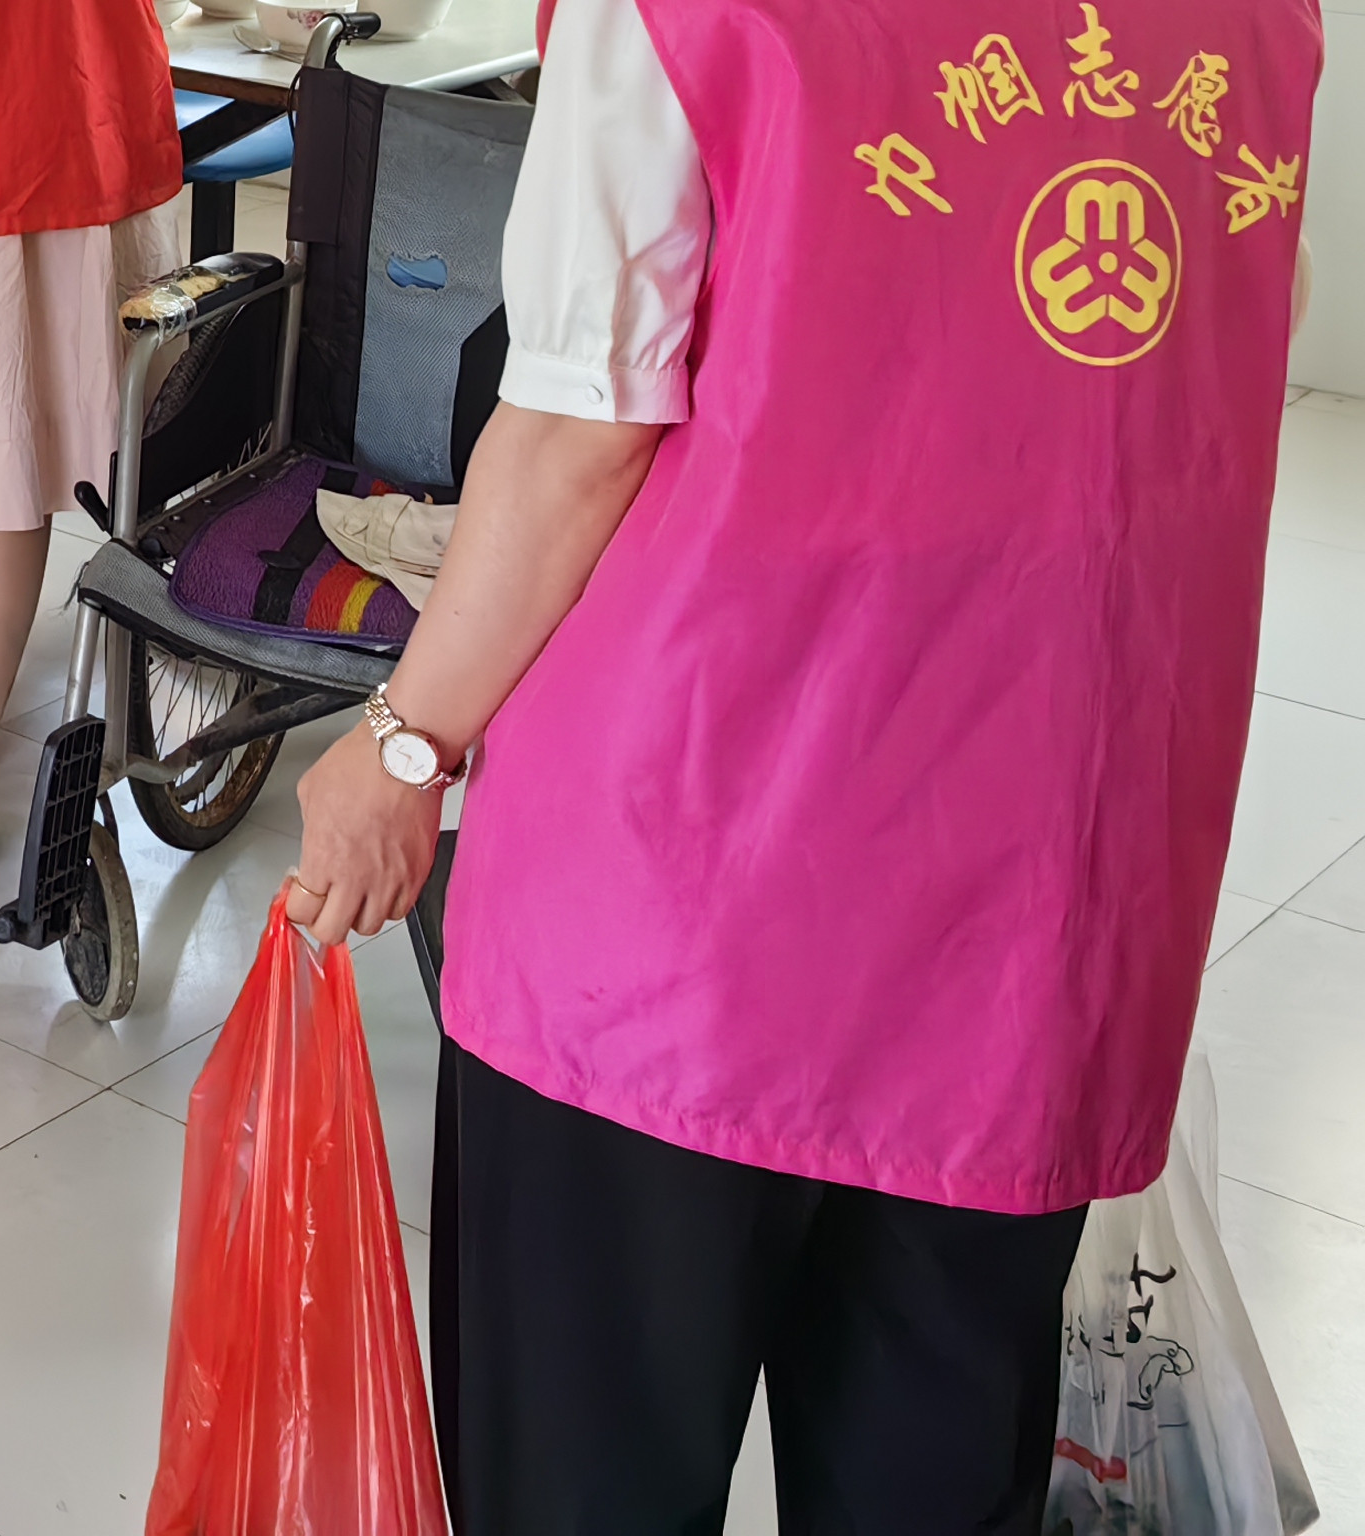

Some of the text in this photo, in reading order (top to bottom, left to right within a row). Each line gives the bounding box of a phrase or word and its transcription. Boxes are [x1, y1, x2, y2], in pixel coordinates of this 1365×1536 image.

[854, 2, 1300, 234] 巾帼志愿者
